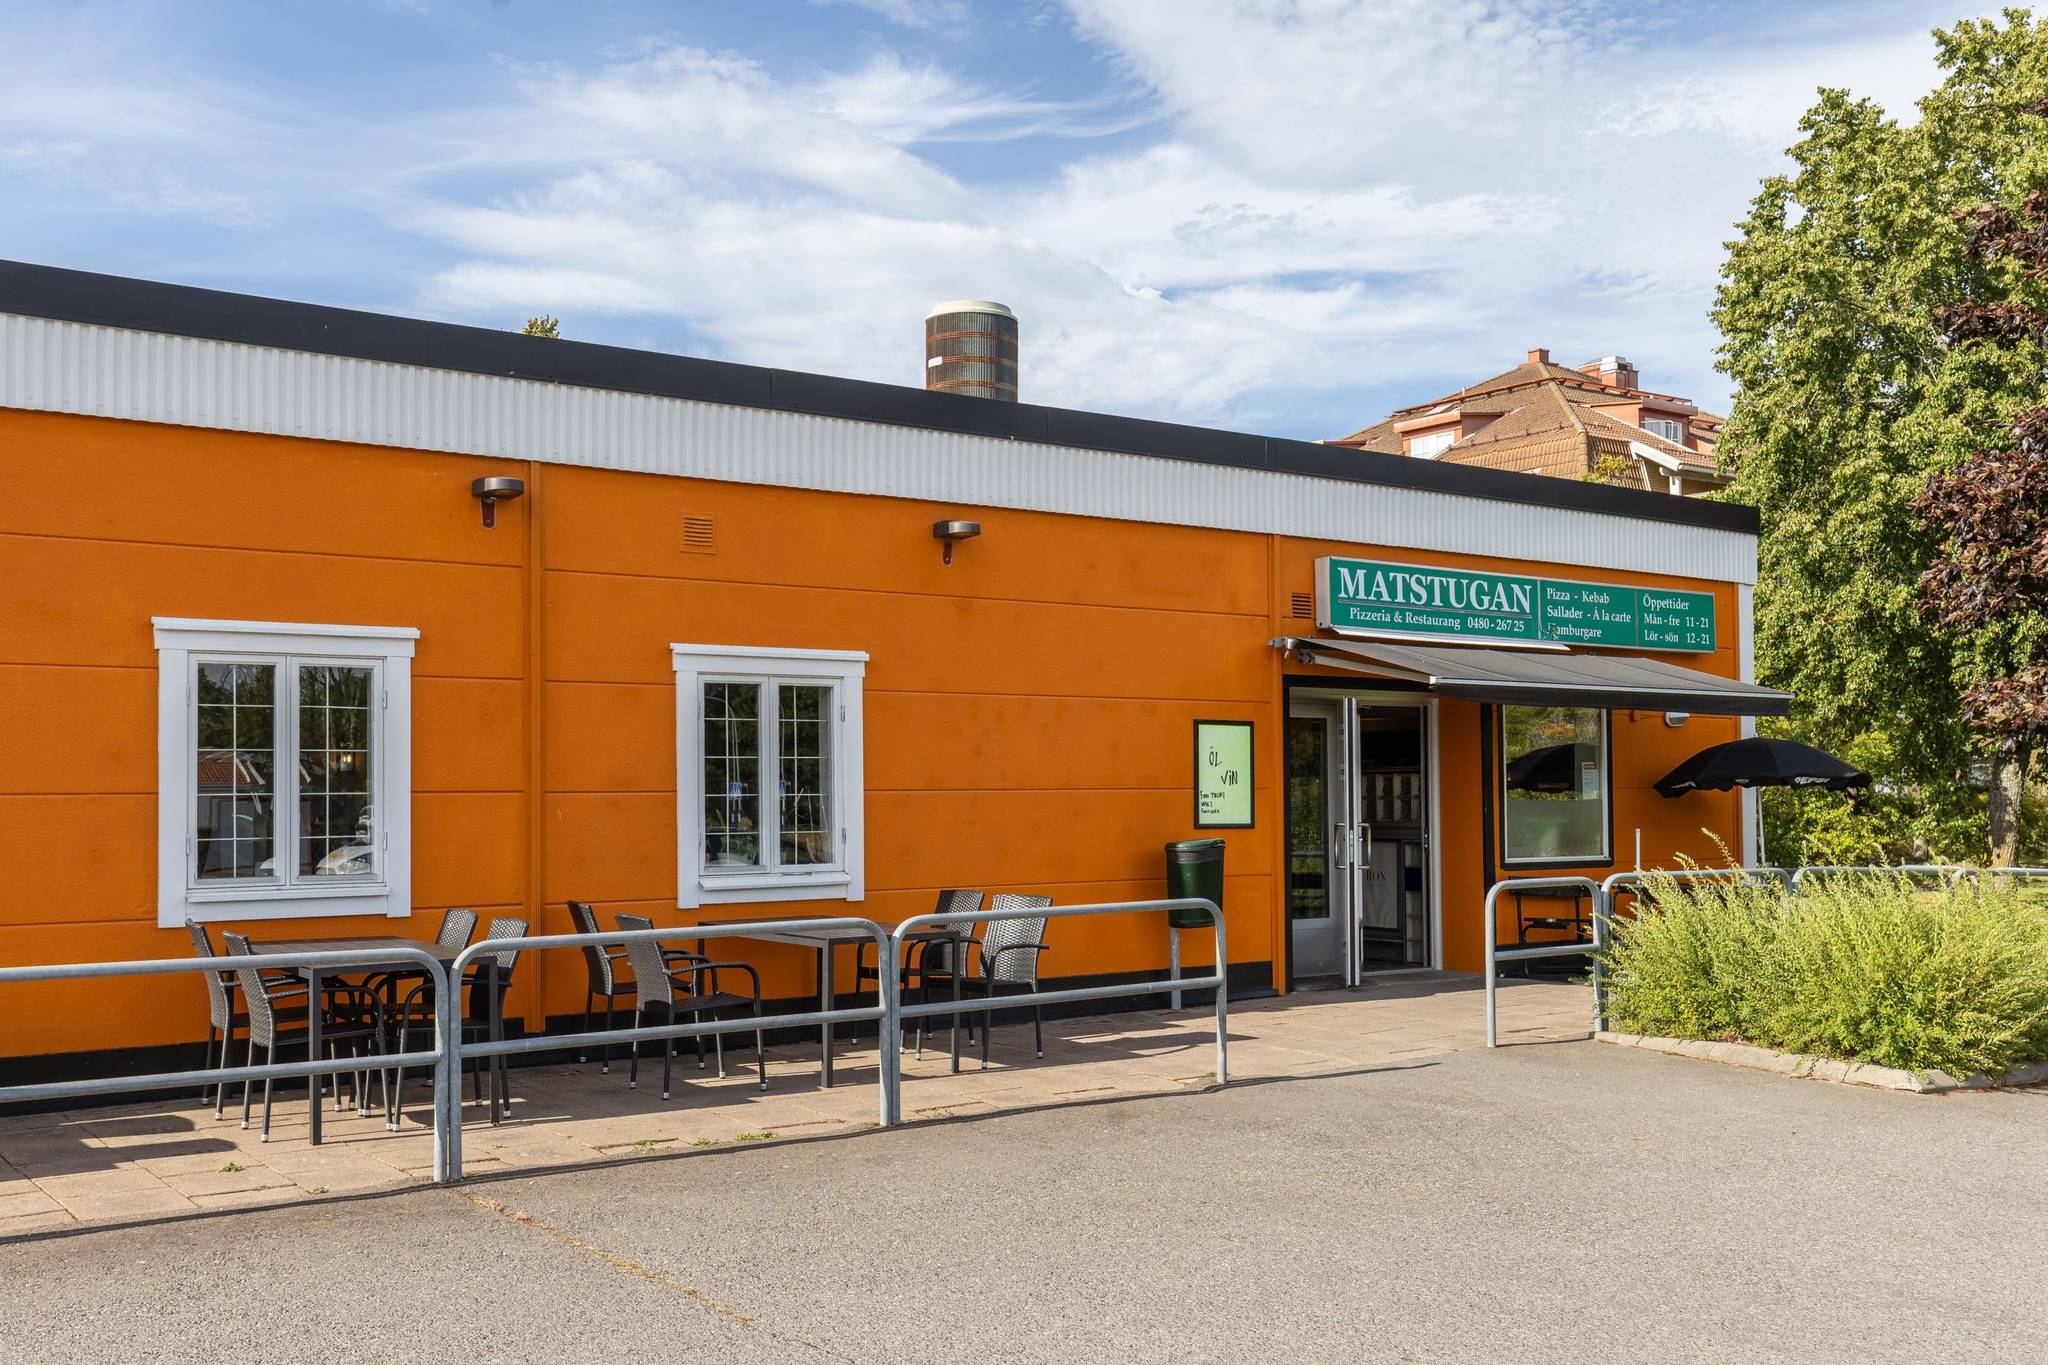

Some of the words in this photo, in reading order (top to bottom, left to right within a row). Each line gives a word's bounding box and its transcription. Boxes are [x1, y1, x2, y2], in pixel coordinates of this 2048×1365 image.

[1338, 567, 1532, 614] MATSTUGAN
[1547, 588, 1570, 601] Pizza
[1582, 591, 1610, 604] Kebab
[1643, 594, 1689, 611] Öppettider
[1350, 608, 1391, 622] Pizzeria
[1394, 611, 1403, 623] &
[1405, 614, 1460, 630] Restaurang
[1547, 606, 1583, 619] Sallader
[1602, 609, 1610, 621] la
[1611, 612, 1631, 623] carte
[1644, 613, 1662, 625] Mån
[1669, 614, 1680, 626] fre
[1645, 630, 1658, 641] Lör
[1665, 632, 1679, 642] sön
[1209, 746, 1223, 767] ÖL
